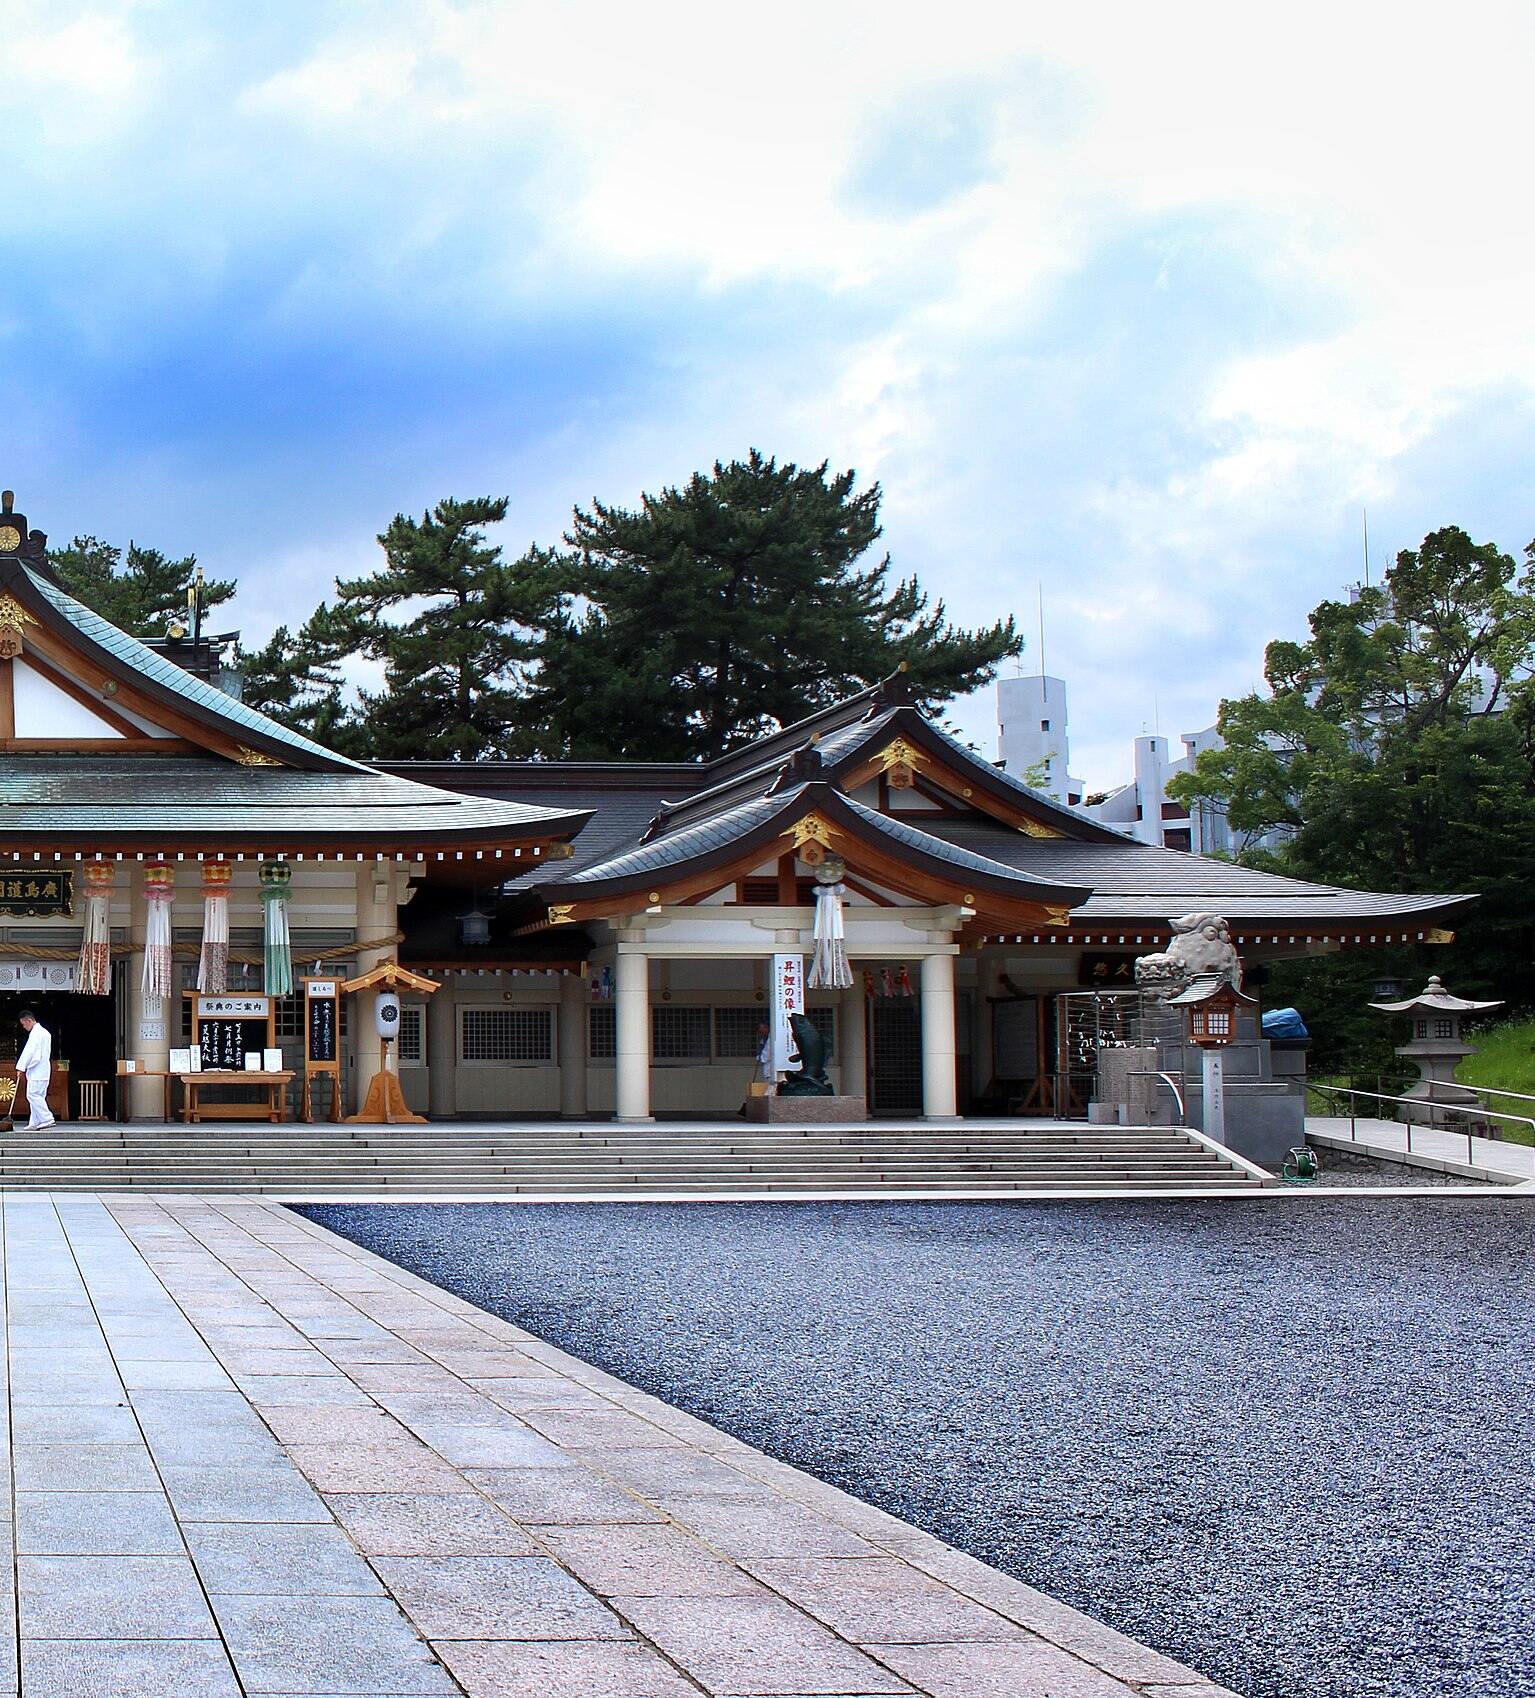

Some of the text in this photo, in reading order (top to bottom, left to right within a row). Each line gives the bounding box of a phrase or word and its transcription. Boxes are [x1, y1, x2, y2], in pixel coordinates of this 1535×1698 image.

[783, 960, 795, 1010] 昇鯉の像
[206, 1002, 262, 1011] 祭典のご案内
